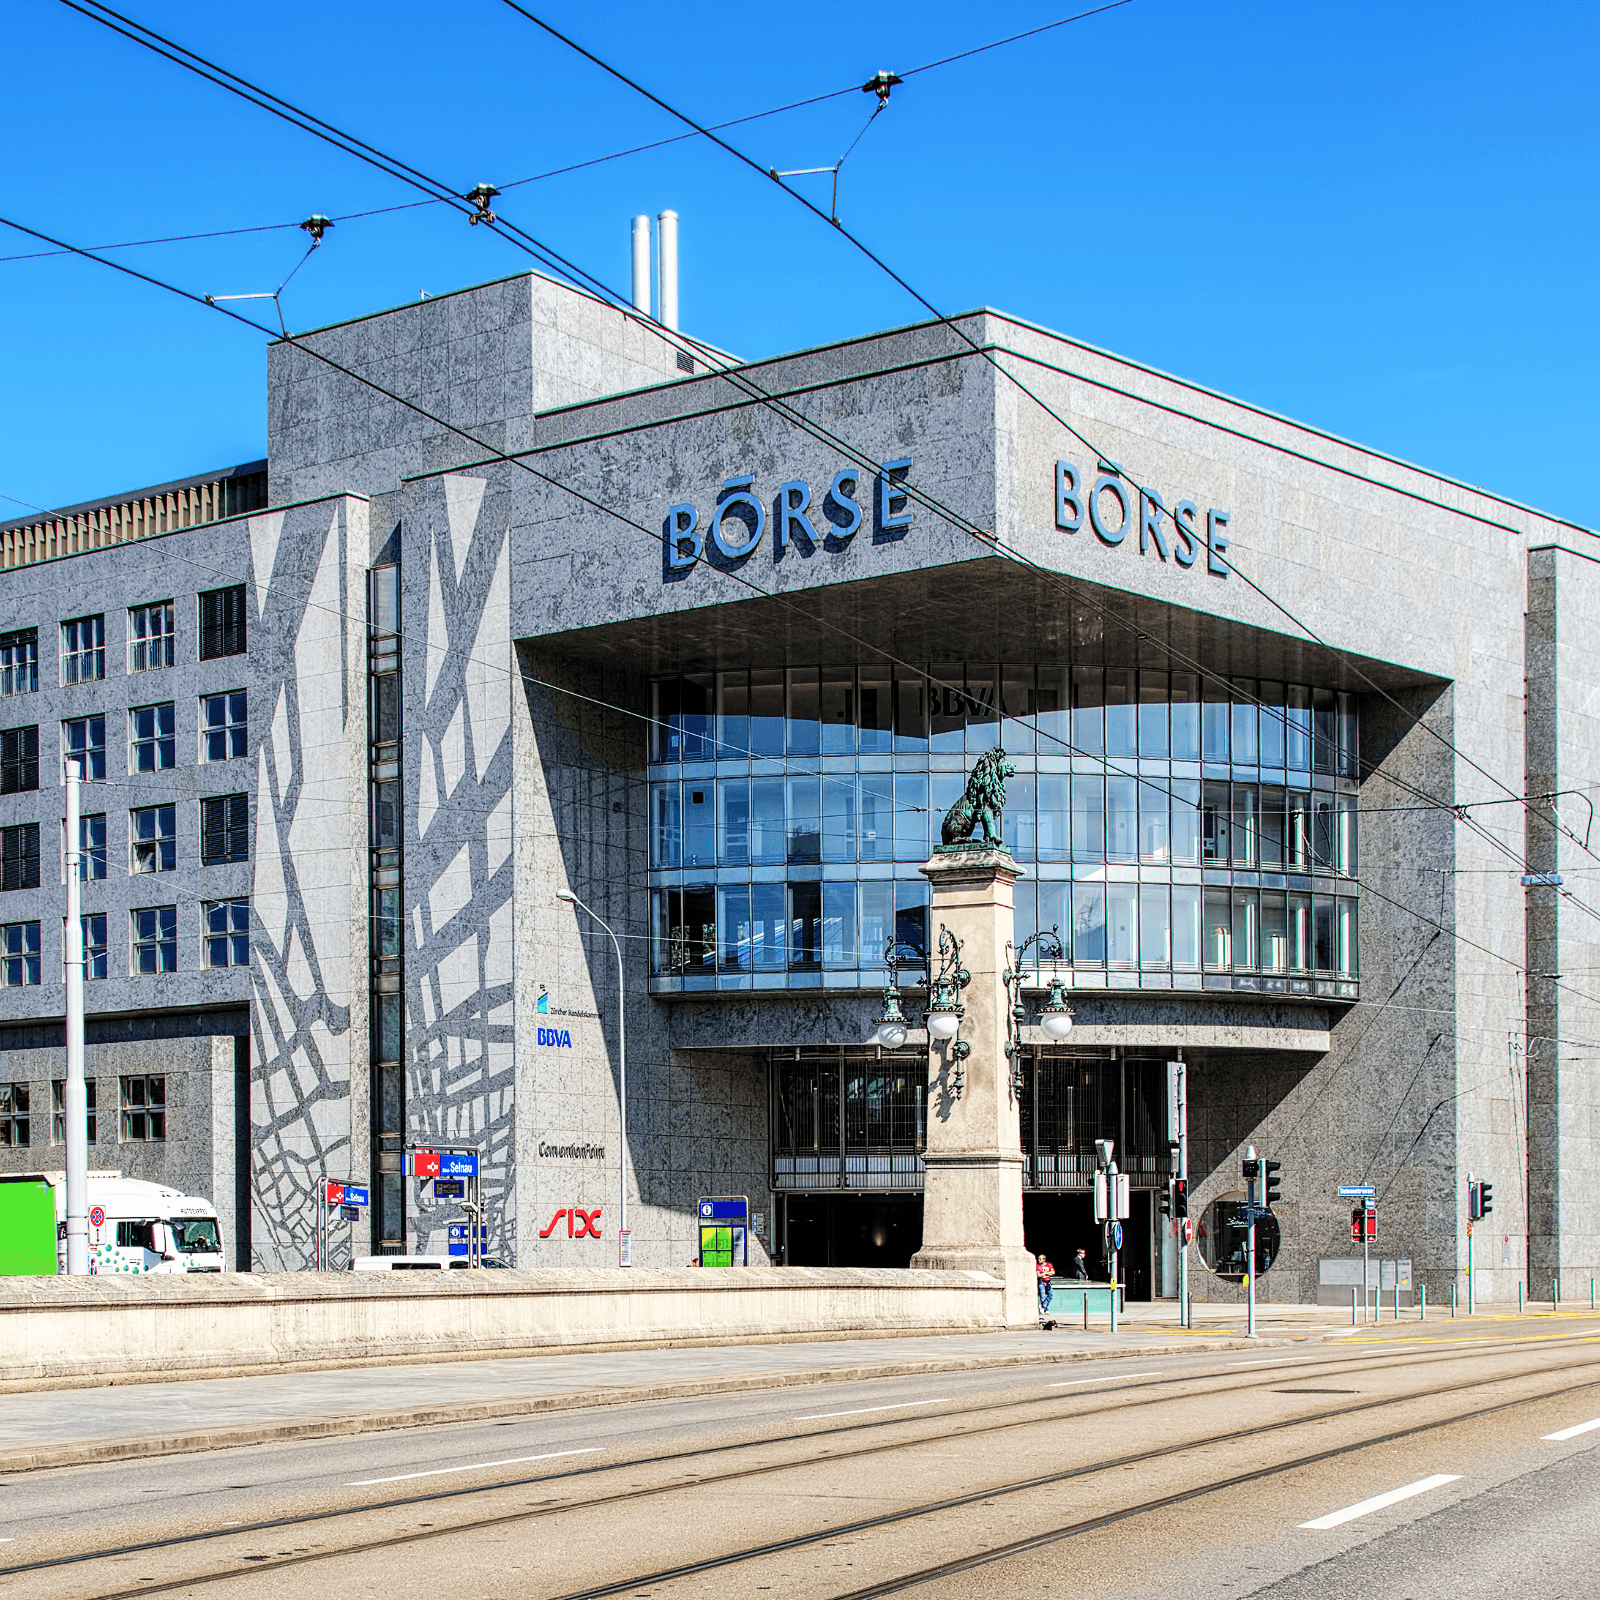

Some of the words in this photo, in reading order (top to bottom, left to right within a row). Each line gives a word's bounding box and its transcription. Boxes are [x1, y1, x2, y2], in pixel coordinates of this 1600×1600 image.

[537, 1027, 572, 1048] BBVA
[450, 1161, 473, 1173] Selnau
[539, 1208, 602, 1238] SIX
